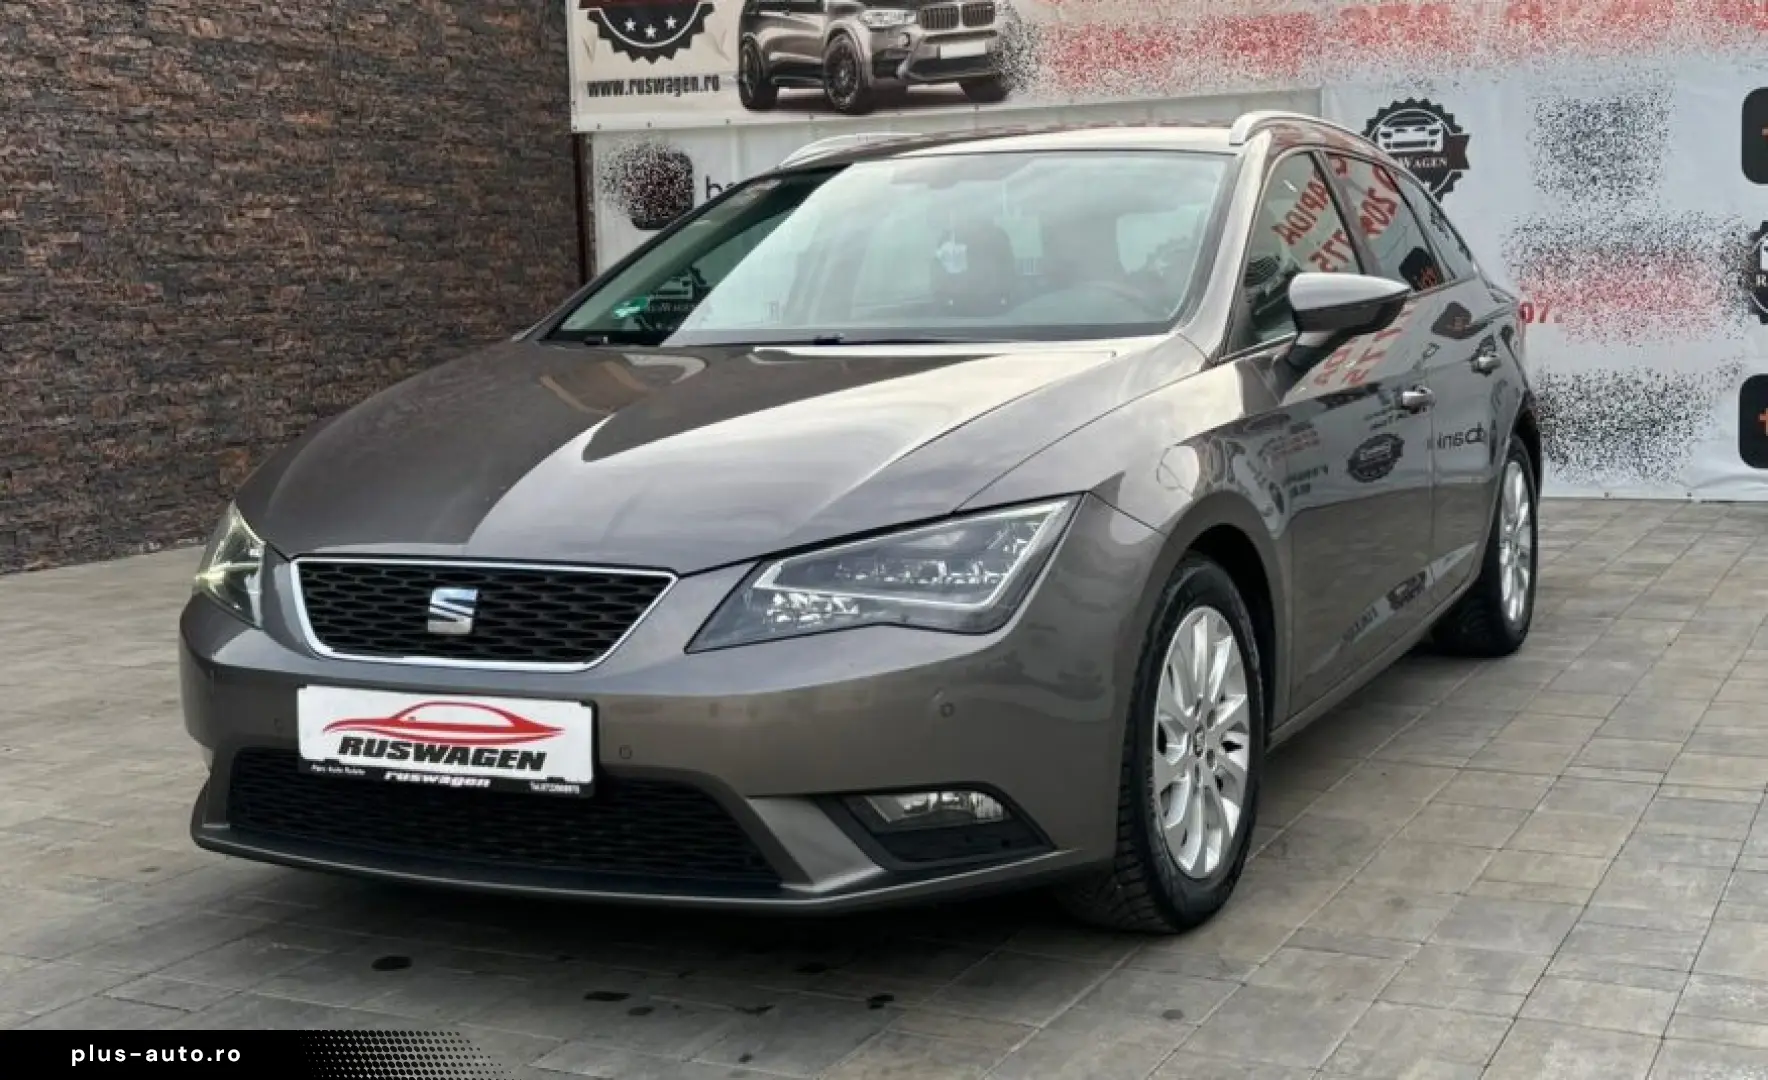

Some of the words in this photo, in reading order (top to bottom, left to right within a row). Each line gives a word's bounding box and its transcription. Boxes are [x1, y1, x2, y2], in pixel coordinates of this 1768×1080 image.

[587, 74, 719, 97] www.ruswagen.ro
[1397, 155, 1448, 169] WAGEN
[338, 736, 547, 772] RUSWAGEN
